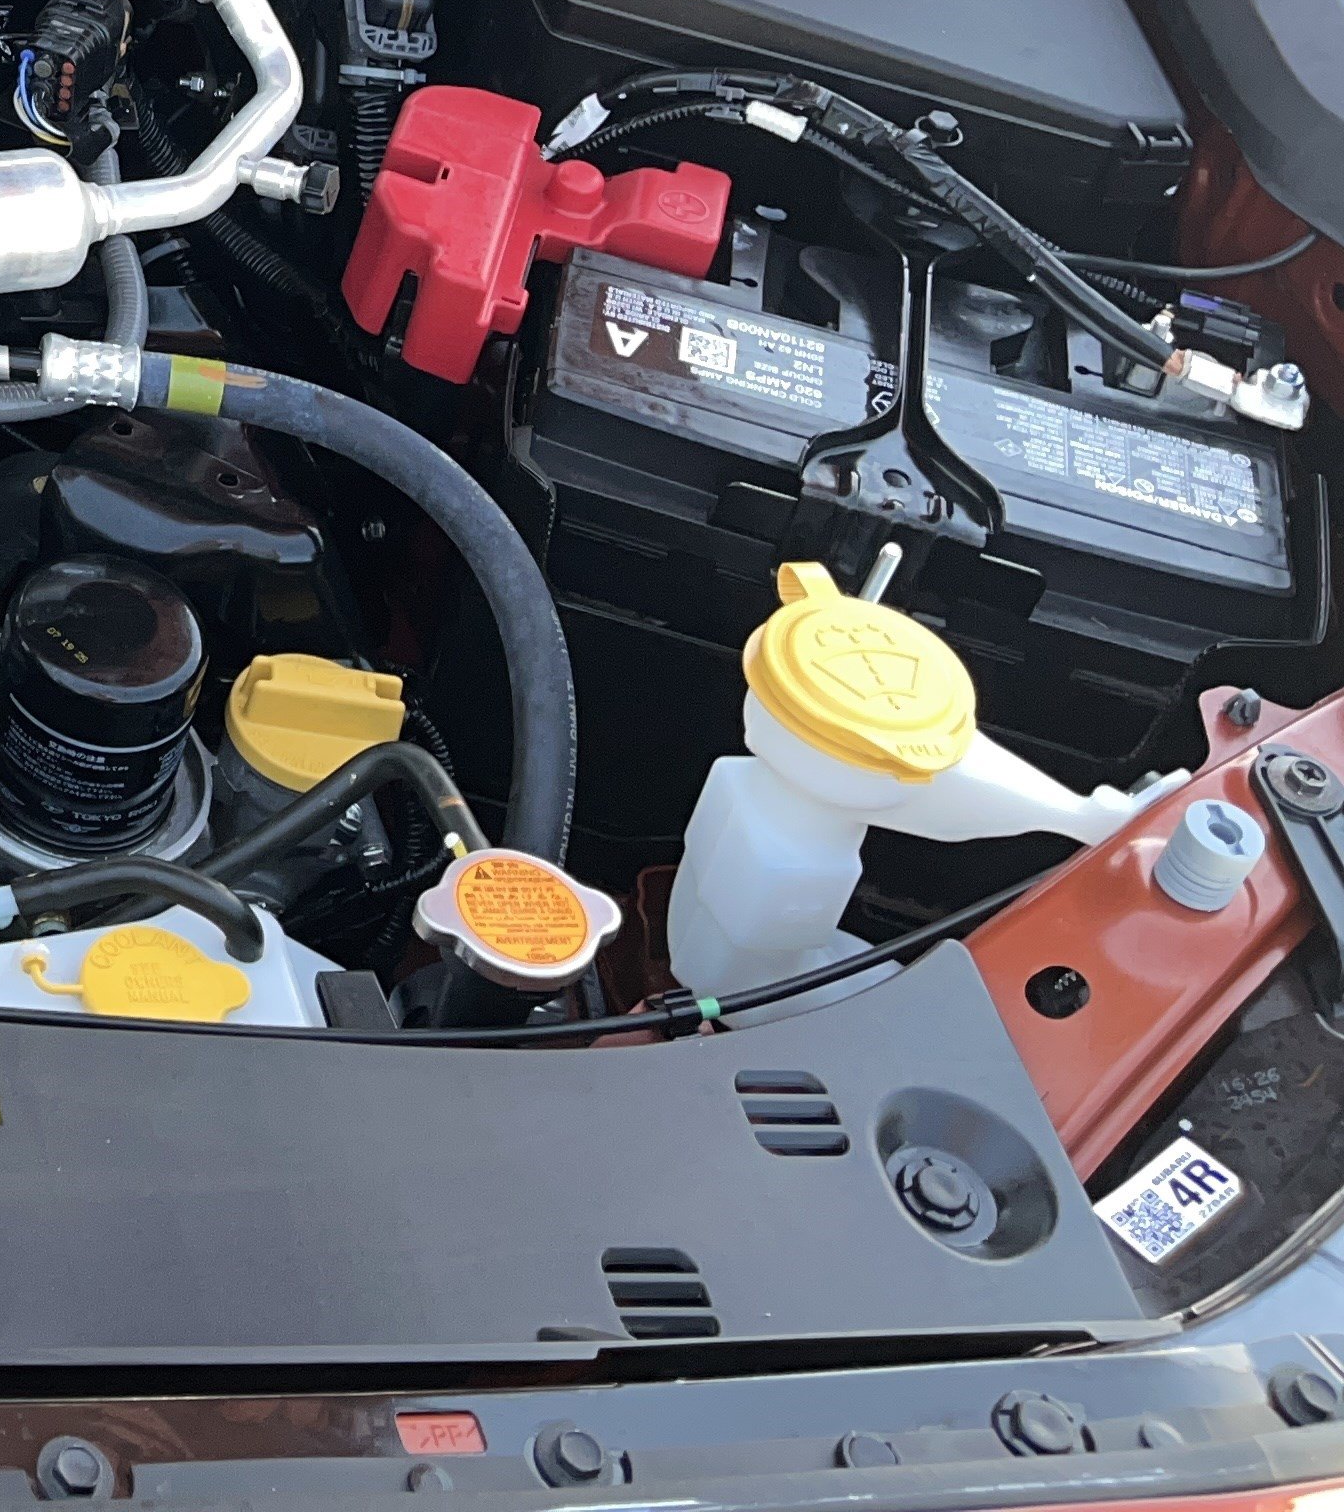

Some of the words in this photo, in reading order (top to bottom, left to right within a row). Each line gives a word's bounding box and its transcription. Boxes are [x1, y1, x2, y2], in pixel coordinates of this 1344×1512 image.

[605, 319, 649, 358] A
[689, 365, 722, 382] AMPS
[752, 360, 779, 374] SIZE
[780, 368, 823, 387] GROUP
[792, 359, 823, 376] LN2
[724, 374, 787, 400] CRANKING
[744, 368, 790, 391] AMPS
[793, 382, 823, 400] 620
[45, 624, 62, 641] 07
[59, 636, 76, 652] 19
[71, 811, 123, 821] TOKYO
[89, 929, 203, 970] COOLANT
[127, 990, 190, 1004] MANUAL
[1150, 1150, 1191, 1186] SUBARU
[1169, 1154, 1229, 1207] 4R
